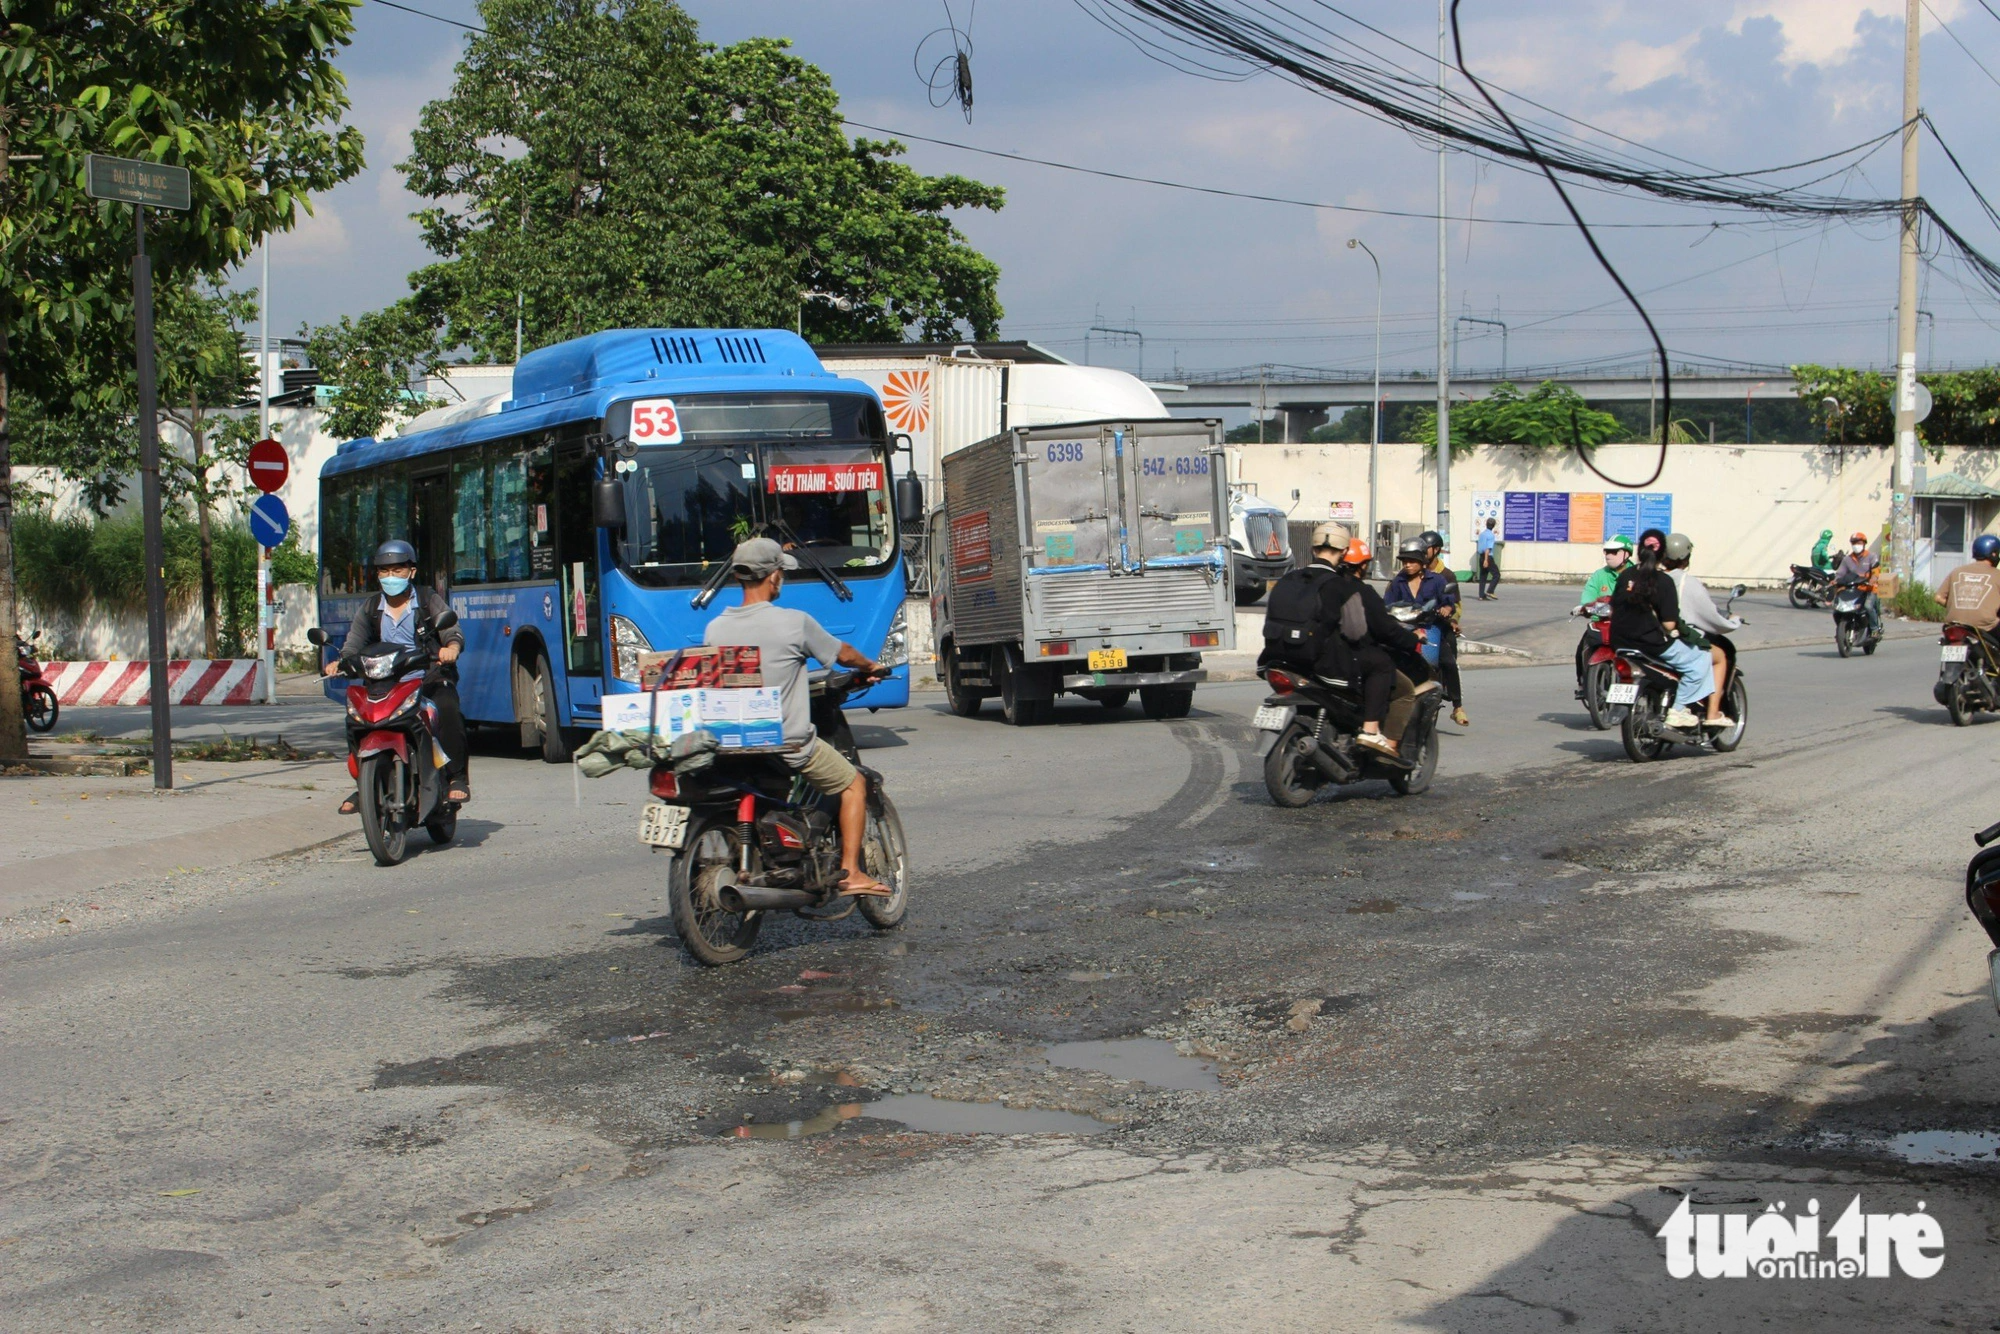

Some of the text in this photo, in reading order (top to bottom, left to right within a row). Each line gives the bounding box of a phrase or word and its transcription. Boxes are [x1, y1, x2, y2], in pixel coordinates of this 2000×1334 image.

[634, 406, 677, 437] 53
[1047, 442, 1084, 463] 6398
[1143, 457, 1165, 476] 54Z
[1175, 456, 1209, 475] 63.98
[796, 469, 826, 491] THÀNH
[834, 466, 855, 491] SUỐI
[857, 468, 877, 489] TIÊN
[1093, 658, 1123, 669] 6398
[1098, 650, 1116, 659] 54Z
